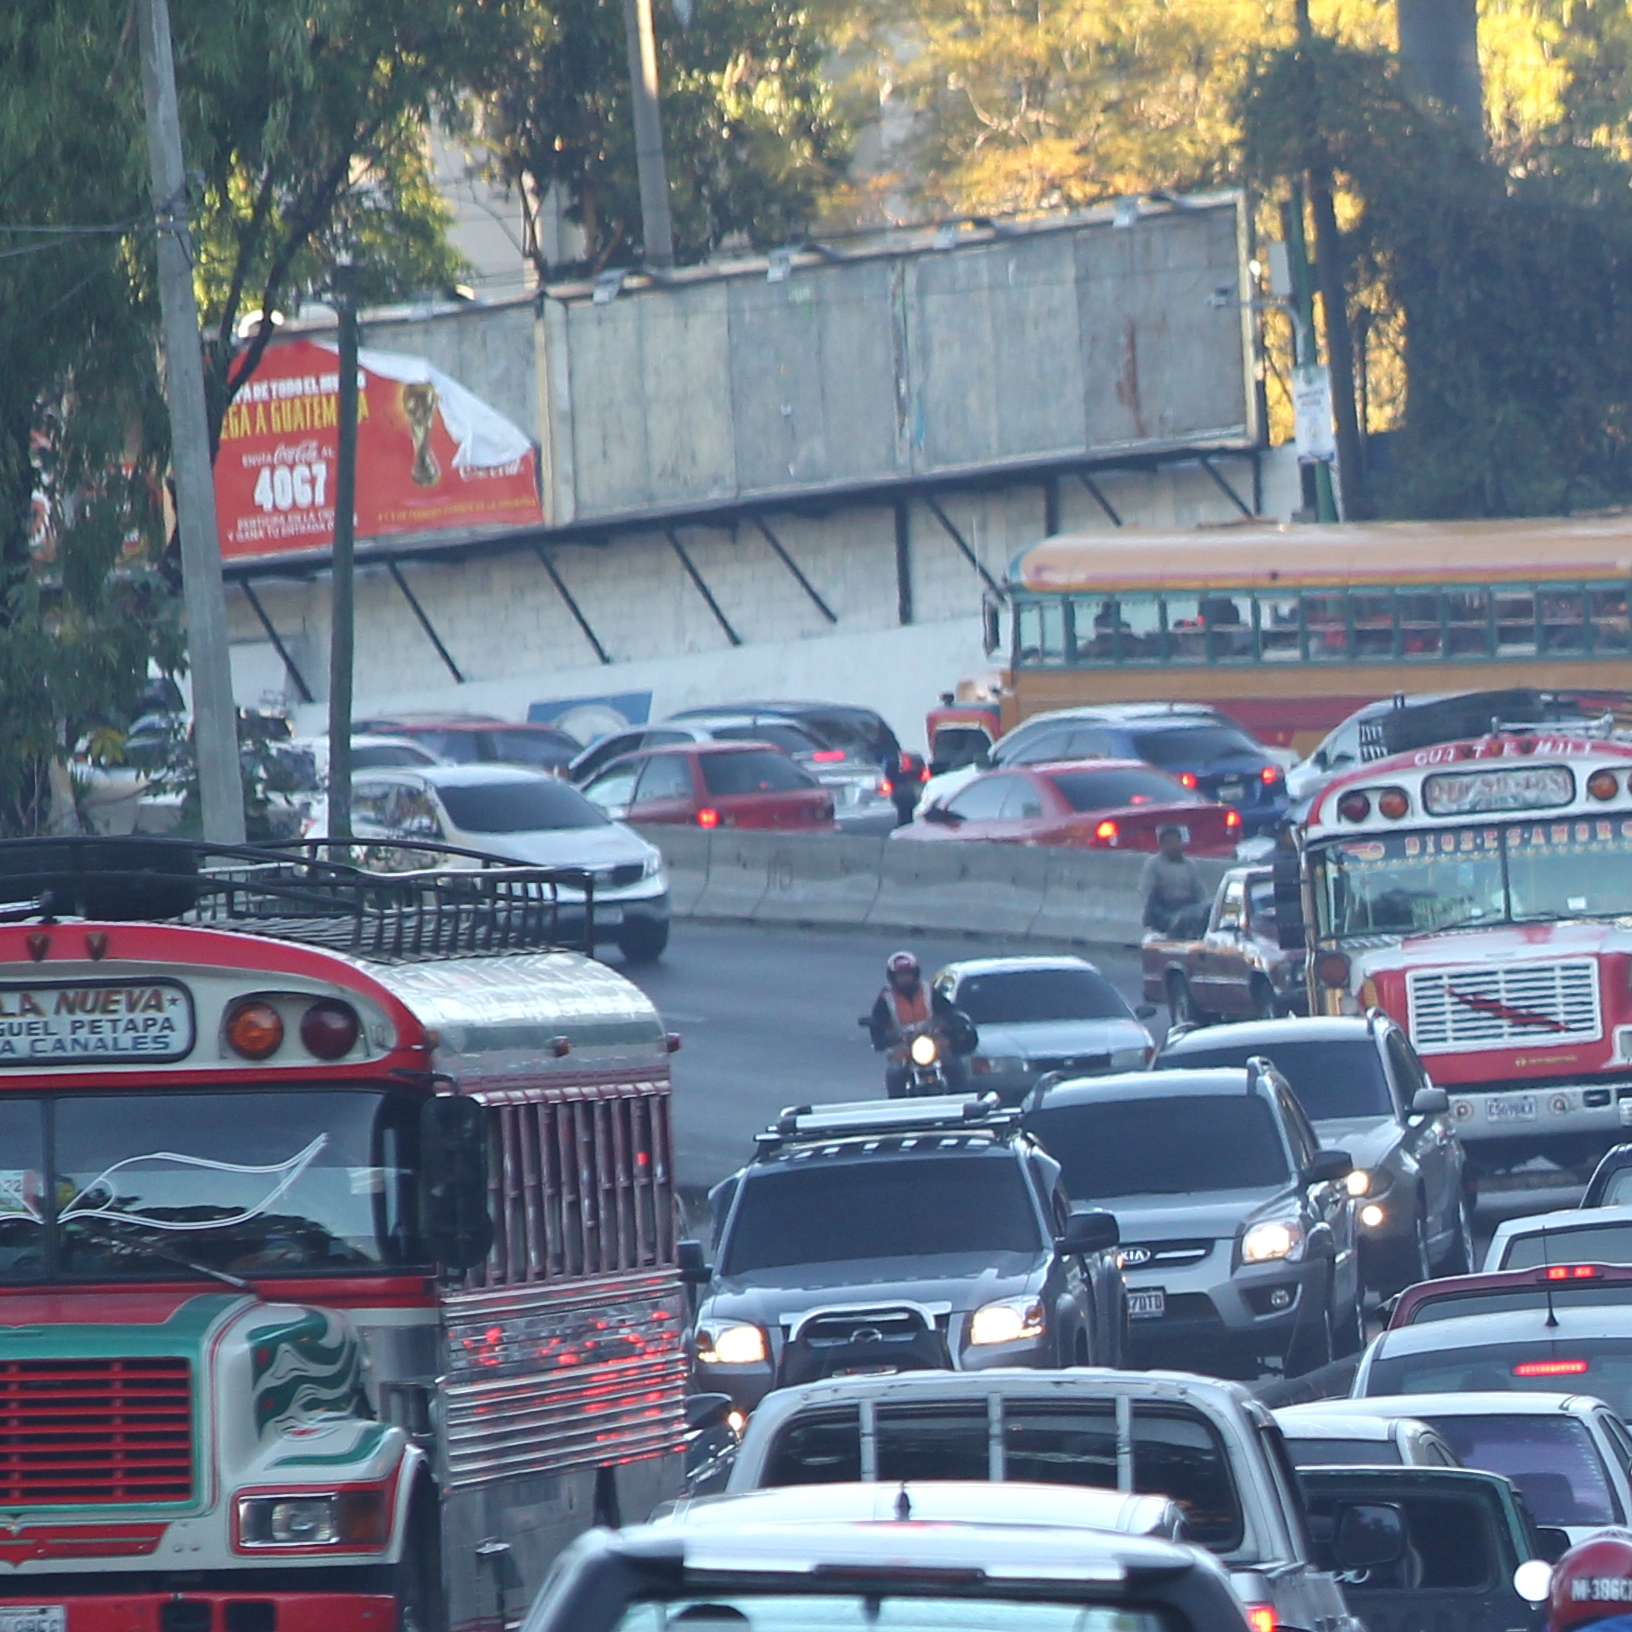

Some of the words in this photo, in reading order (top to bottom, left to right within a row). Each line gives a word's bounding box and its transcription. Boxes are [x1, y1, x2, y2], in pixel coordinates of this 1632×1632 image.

[254, 402, 268, 435] A
[270, 390, 370, 433] GUATEMA
[254, 461, 328, 512] 4067
[53, 988, 166, 1017] NUEVA
[69, 1017, 176, 1036] PETAPA
[29, 1034, 171, 1053] CANALES
[1120, 1249, 1145, 1261] KIA
